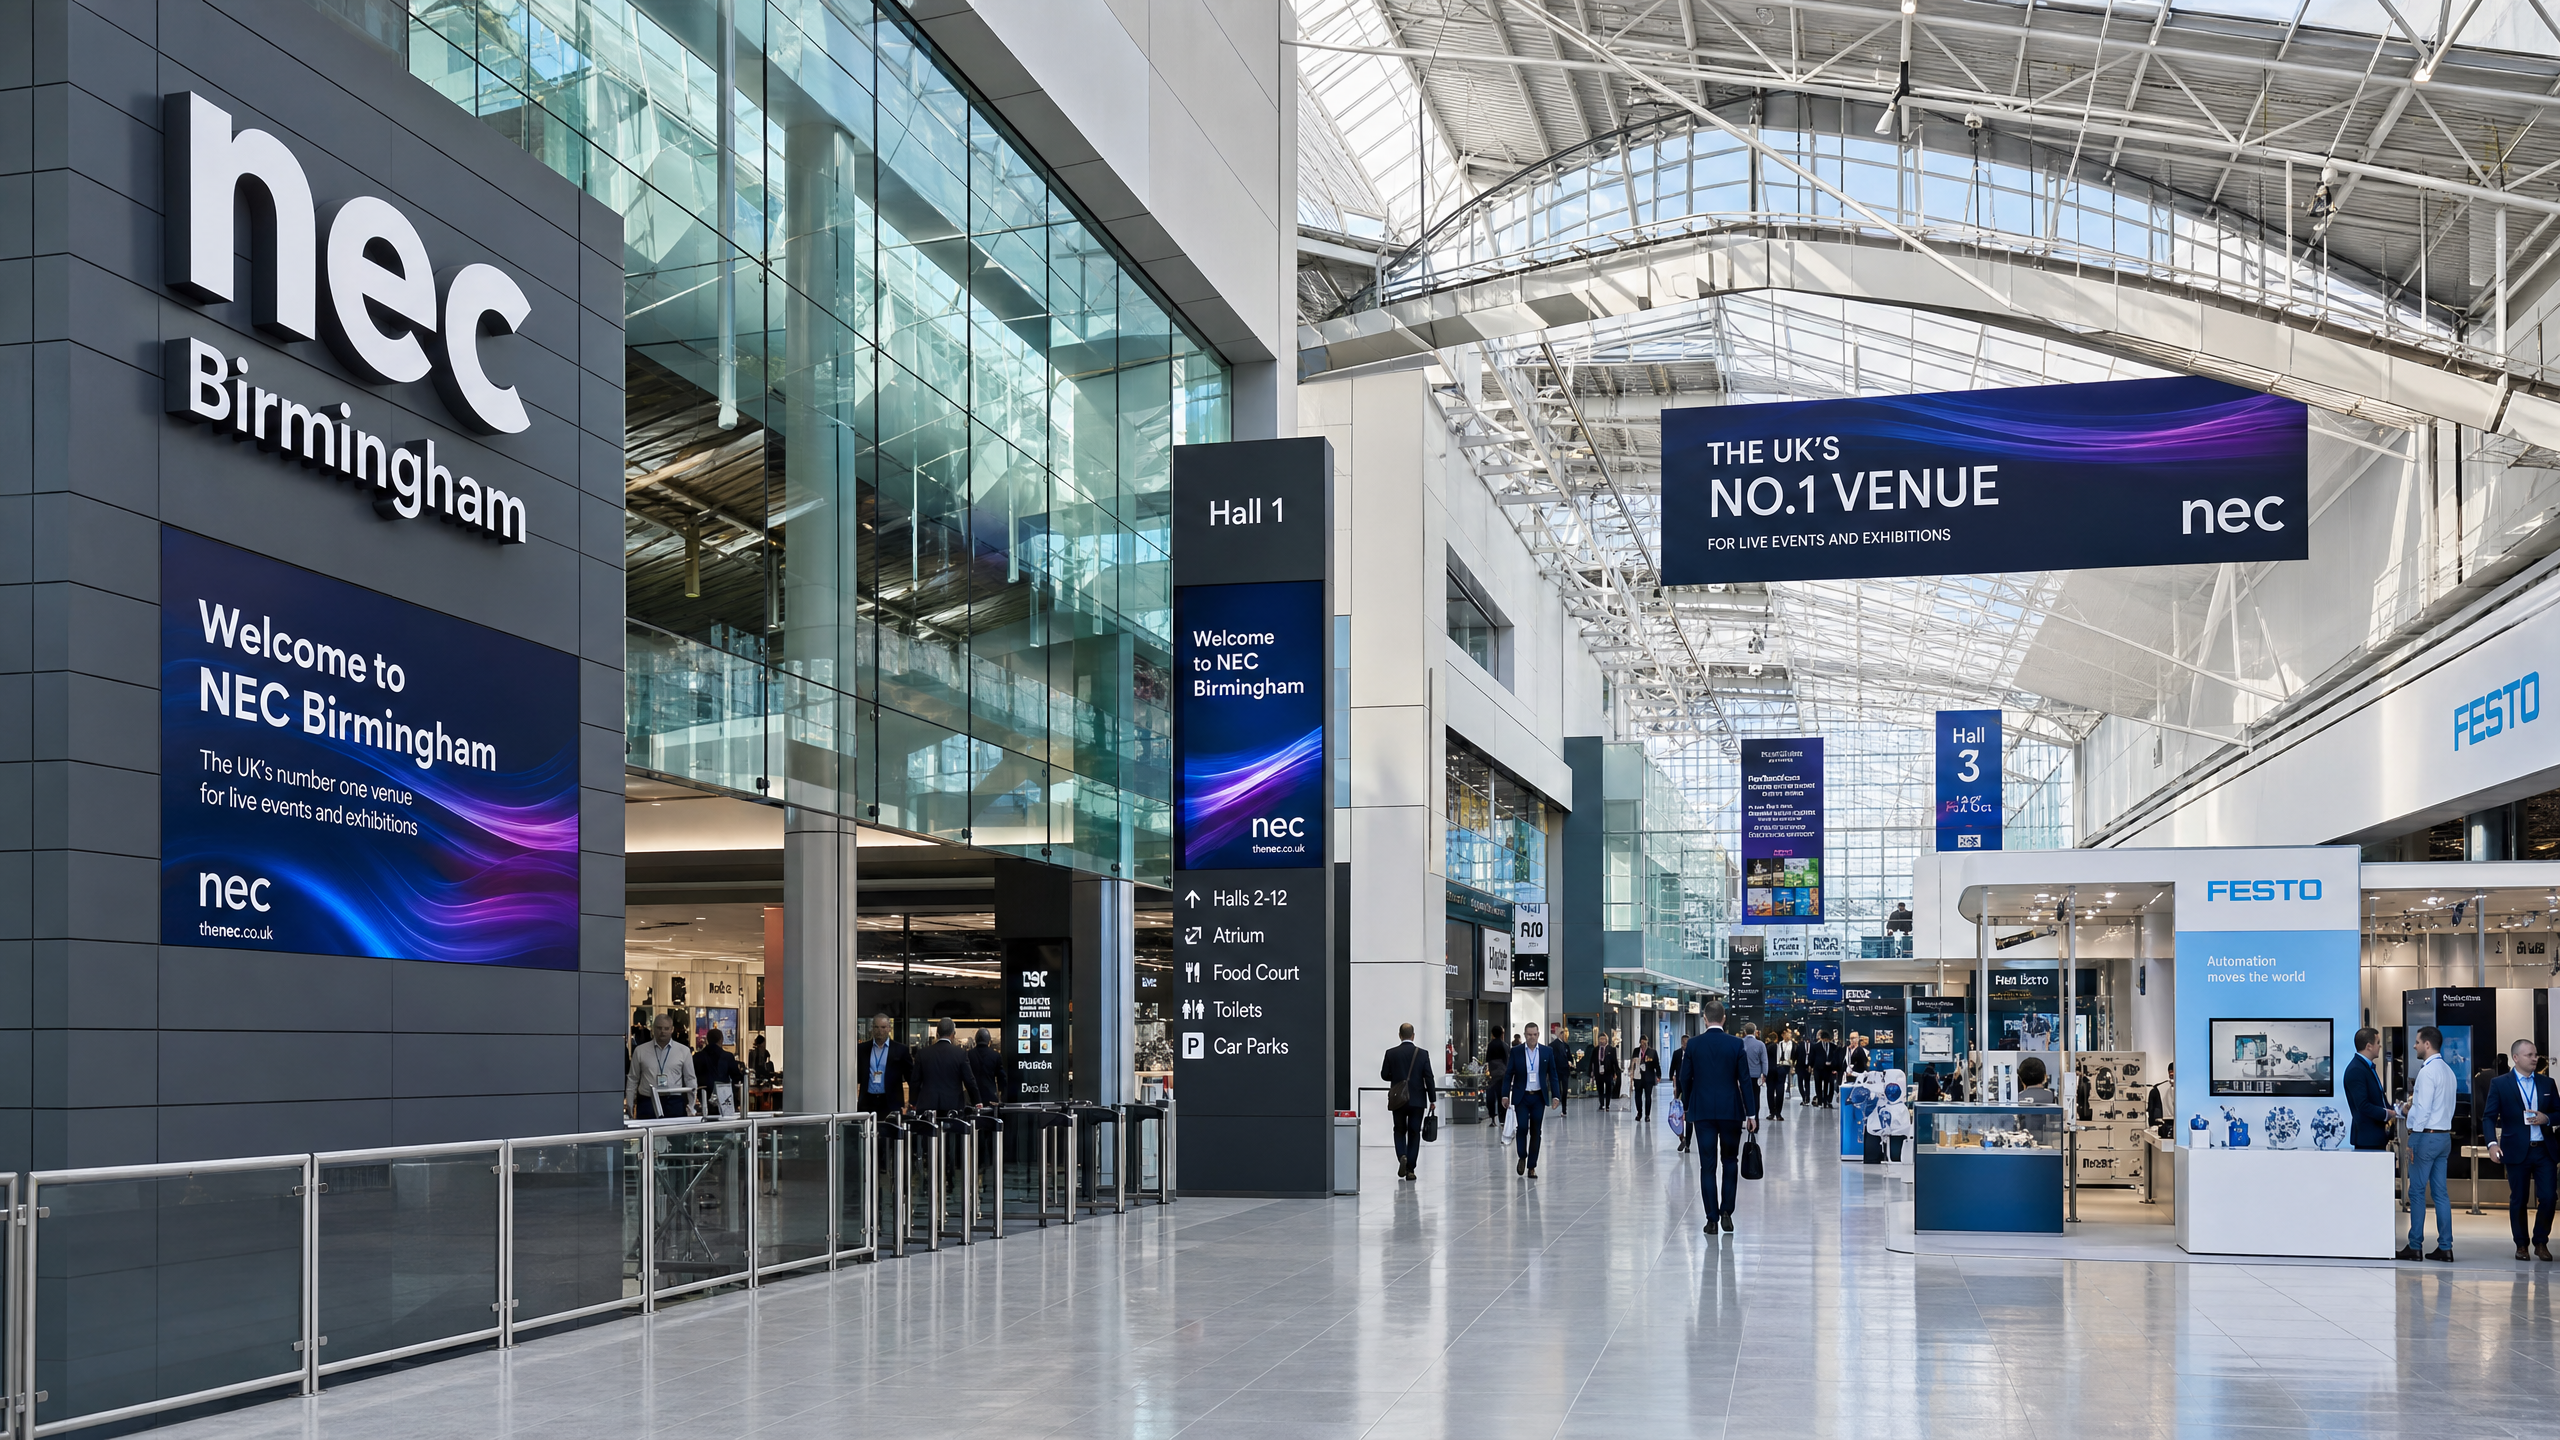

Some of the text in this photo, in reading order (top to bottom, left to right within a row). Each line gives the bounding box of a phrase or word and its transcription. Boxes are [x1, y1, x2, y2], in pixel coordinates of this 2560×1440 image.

[190, 90, 532, 434] nec
[190, 336, 527, 544] Birmingham
[1706, 440, 1764, 466] THE
[1711, 464, 1999, 518] NO.1 VENUE
[1210, 497, 1284, 526] Hall 1
[2182, 495, 2285, 535] nec
[1708, 528, 1951, 551] FOR LIVE EVENTS AND EXHIBITIONS
[198, 598, 406, 693] Welcome to
[1193, 630, 1275, 647] Welcome
[1193, 652, 1259, 672] to NEC
[1193, 677, 1305, 700] Birmingham
[200, 666, 497, 771] NEC Birmingham
[2454, 671, 2540, 752] FESTO
[1953, 726, 1985, 744] Hall
[199, 748, 233, 775] The
[277, 768, 337, 793] number
[339, 780, 368, 799] one
[370, 785, 414, 807] venue
[1957, 749, 1980, 783] 3
[199, 781, 419, 837] for live events and exhibitions
[1252, 817, 1305, 838] nec
[1252, 843, 1305, 854] thenec.co.uk
[199, 872, 272, 913] nec
[1213, 889, 1288, 907] Halls 2-12
[2207, 879, 2323, 902] FESTO
[198, 922, 274, 940] thenec.co.uk
[1213, 926, 1265, 944] Atrium
[1213, 963, 1300, 981] Food Court
[2207, 955, 2277, 967] Automation
[2207, 970, 2306, 982] moves the world
[1213, 1000, 1263, 1018] Toilets
[1187, 1037, 1289, 1055] P Car Parks
